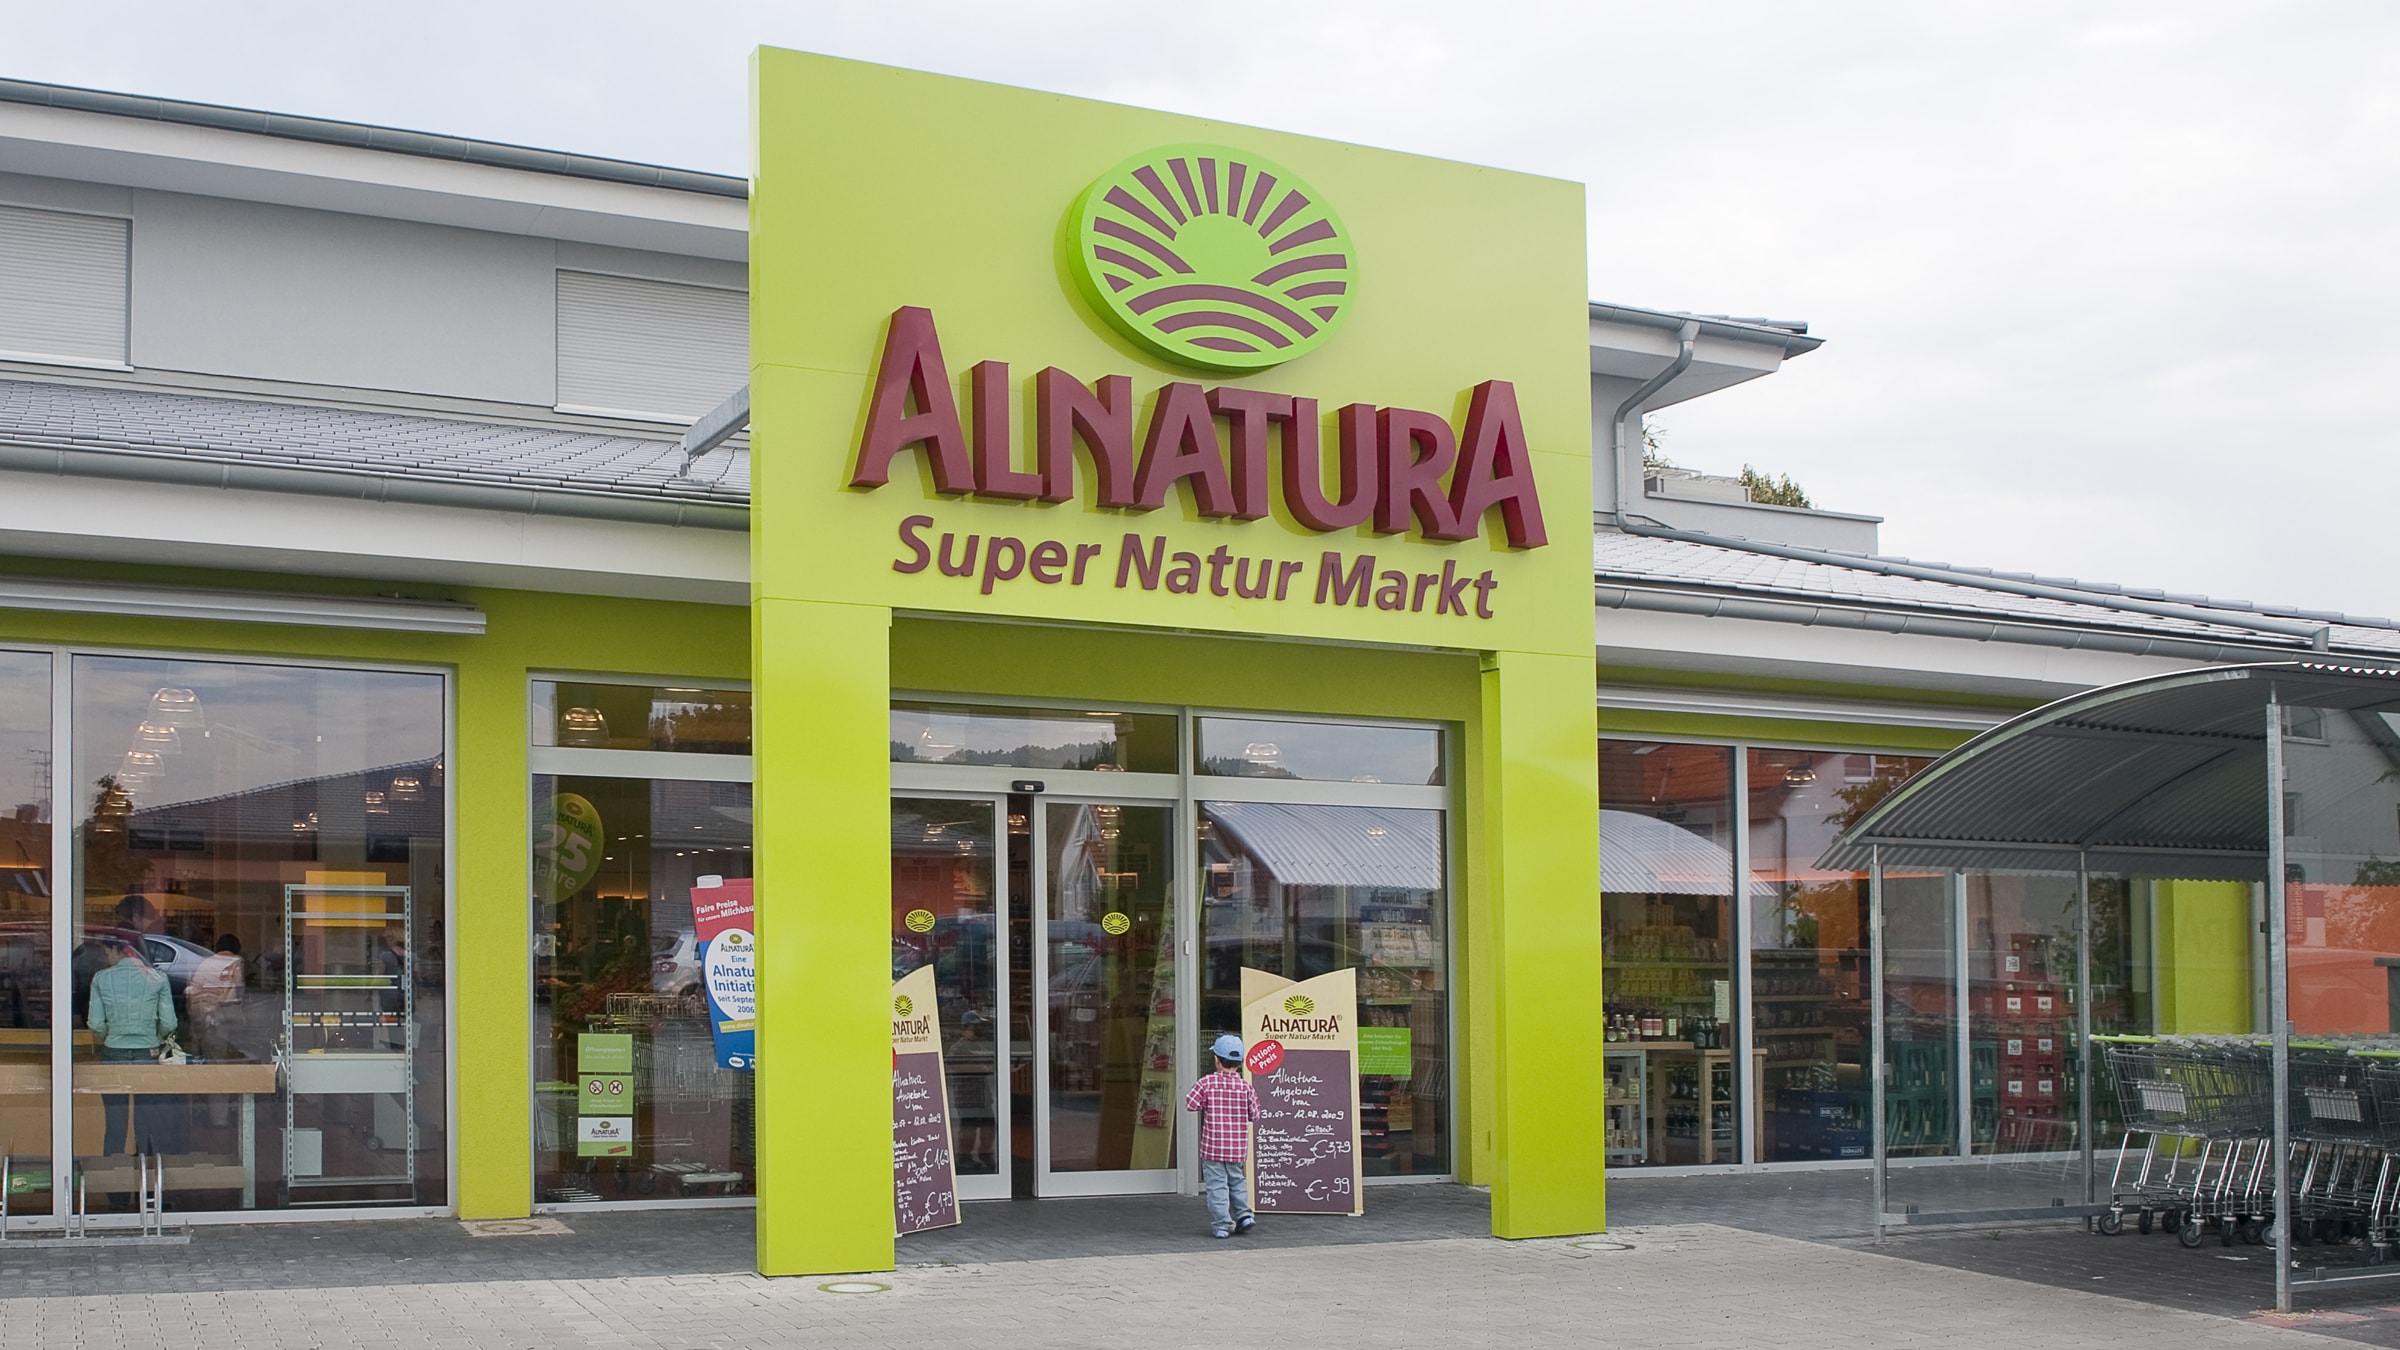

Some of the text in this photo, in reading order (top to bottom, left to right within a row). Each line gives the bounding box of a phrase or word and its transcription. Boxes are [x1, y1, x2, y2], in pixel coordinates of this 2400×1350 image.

[849, 305, 1548, 549] ALNATURA
[893, 514, 1498, 619] Super Natur Markt
[534, 823, 593, 872] 25
[696, 899, 738, 914] Faire Preise
[720, 943, 754, 952] ALNATURA
[1261, 1014, 1339, 1032] ALNATURA
[1249, 1042, 1276, 1067] Aktions
[1258, 1054, 1278, 1069] Preis
[892, 1069, 926, 1088] Alnatura
[1268, 1068, 1323, 1084] Alnatura
[896, 1088, 930, 1109] Angebote
[1270, 1086, 1319, 1102] Angebote
[1292, 1097, 1310, 1106] vom
[1258, 1179, 1298, 1188] Mozzarella
